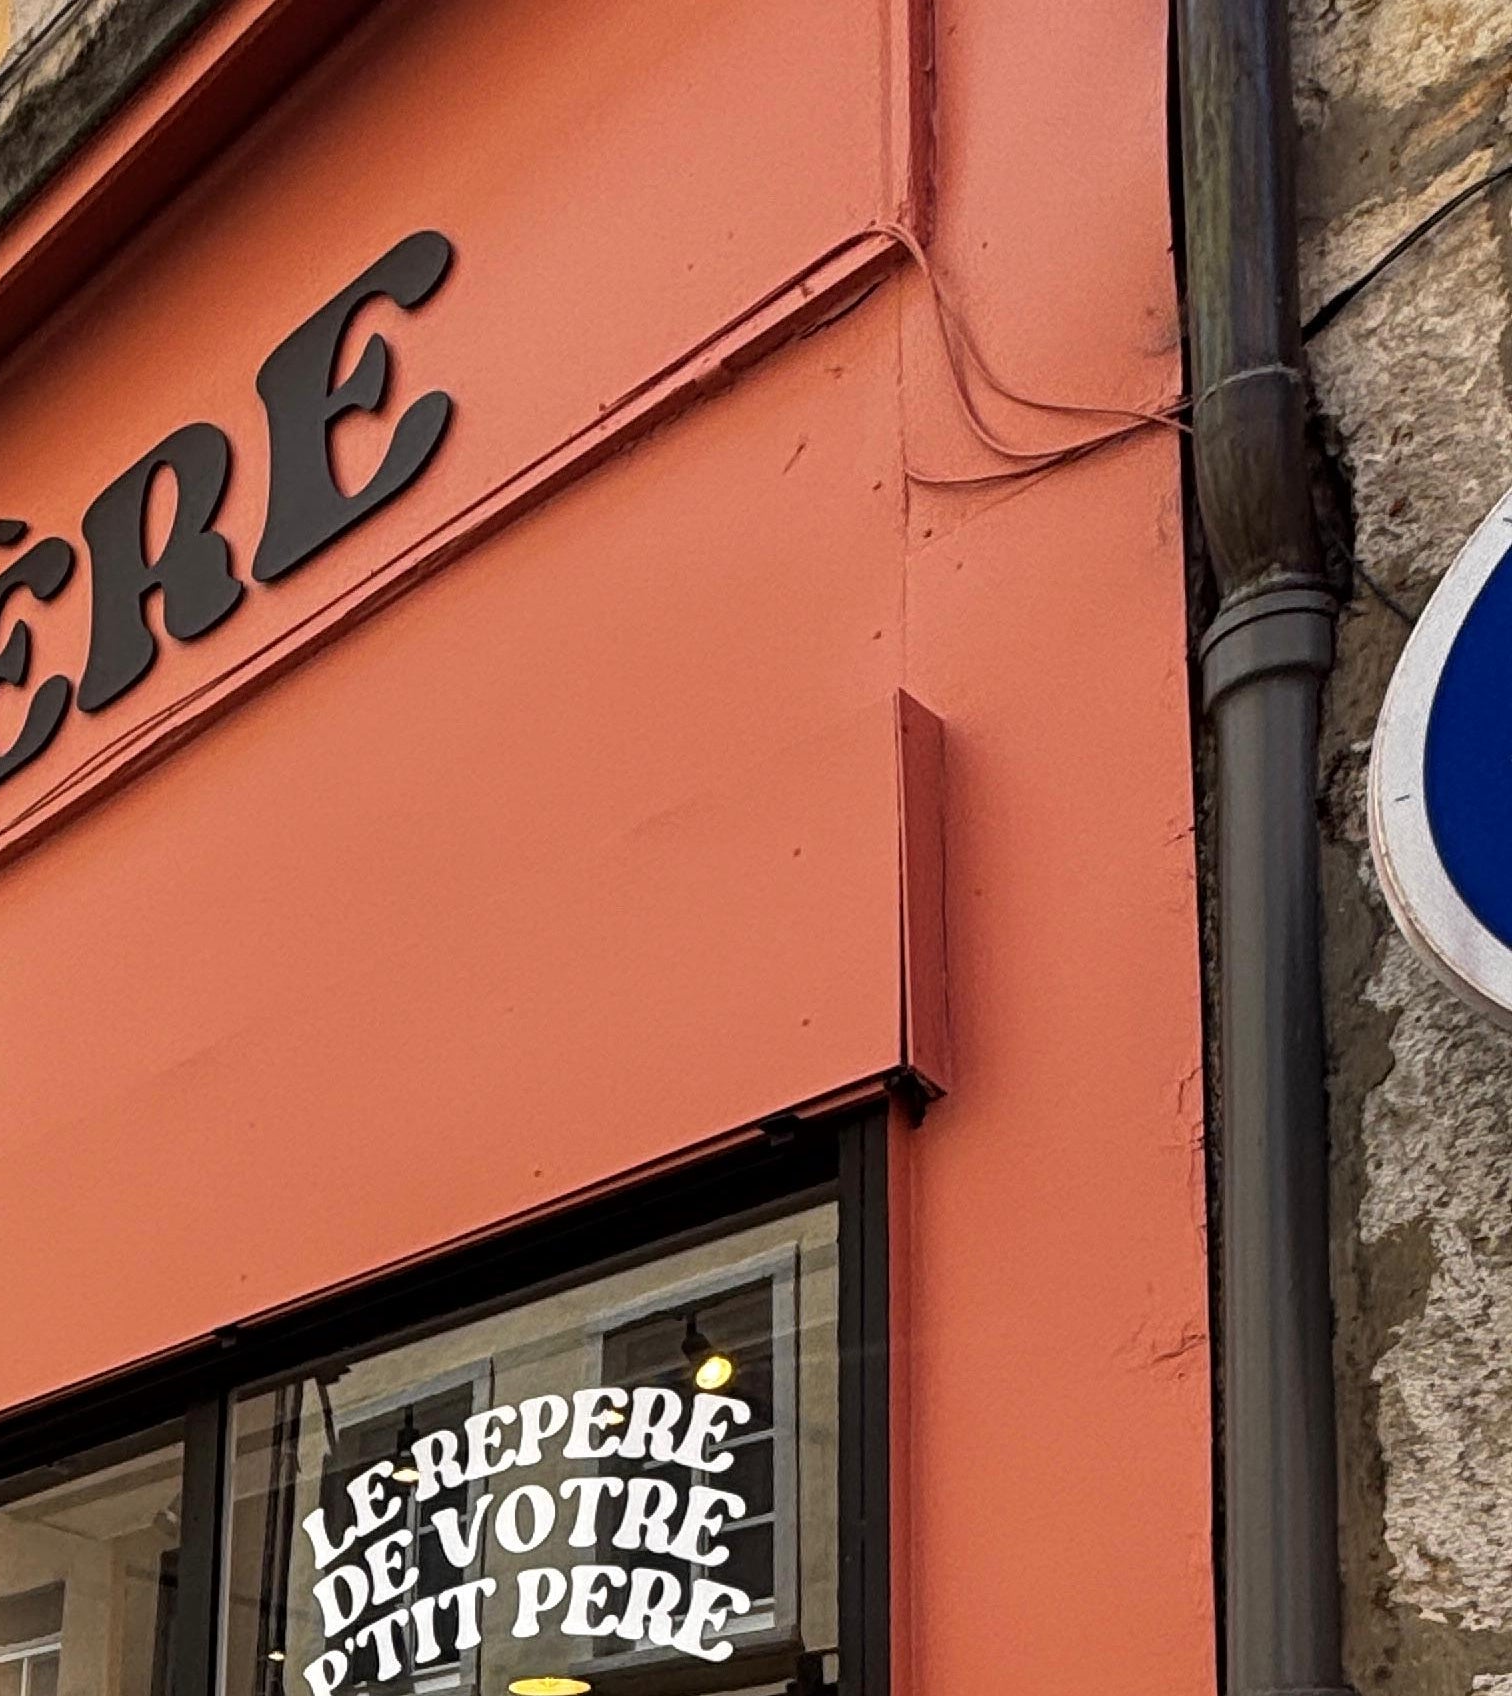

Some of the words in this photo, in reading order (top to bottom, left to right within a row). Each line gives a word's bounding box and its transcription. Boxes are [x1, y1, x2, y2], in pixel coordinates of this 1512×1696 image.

[302, 1460, 401, 1569] LE
[410, 1386, 752, 1501] REPERE
[313, 1528, 419, 1637] DE
[430, 1477, 746, 1567] VOTRE
[511, 1564, 751, 1663] PERE
